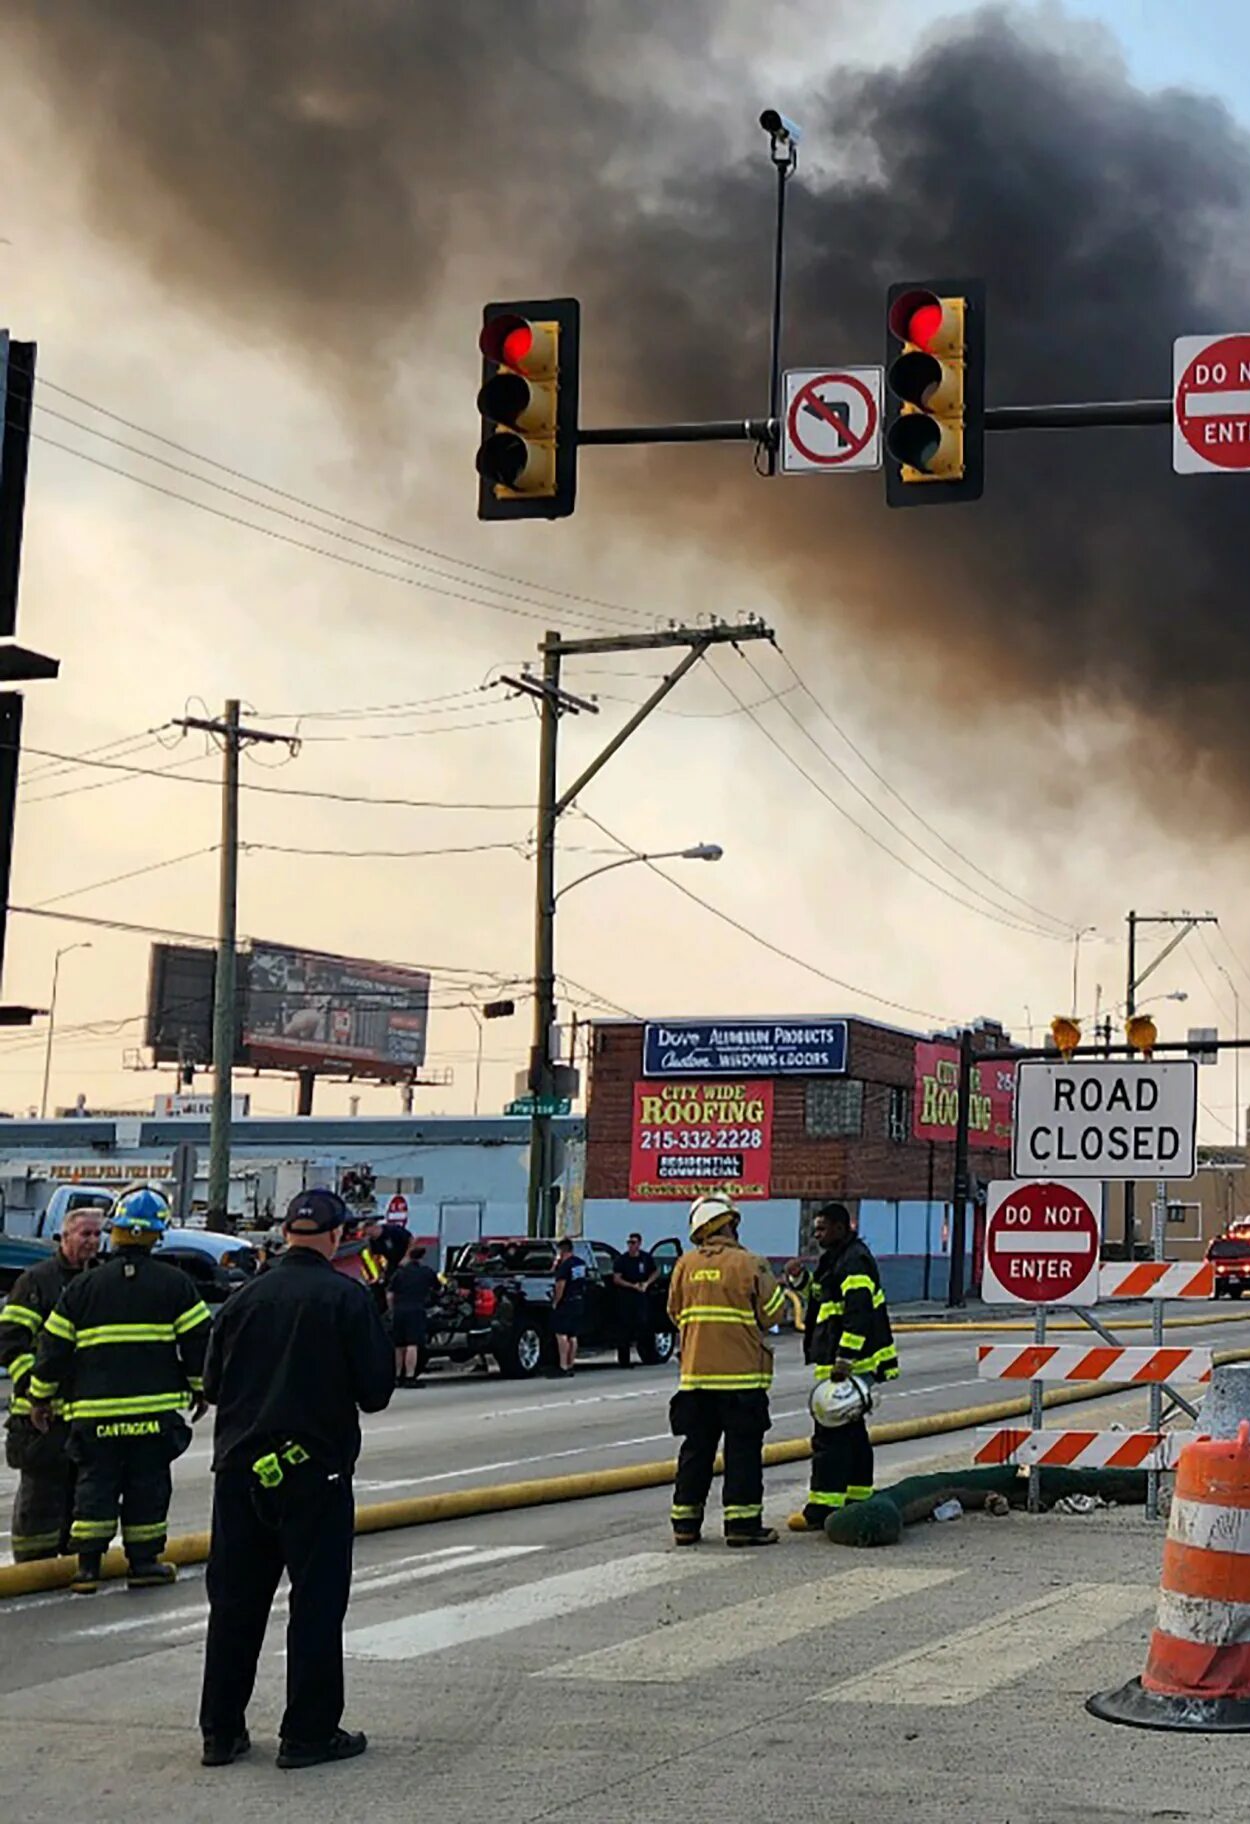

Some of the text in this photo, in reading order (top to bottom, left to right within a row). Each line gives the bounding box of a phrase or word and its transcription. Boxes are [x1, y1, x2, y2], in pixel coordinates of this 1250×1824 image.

[1195, 363, 1227, 385] DO
[774, 1027, 834, 1044] PRODUCTS
[718, 1053, 778, 1068] WINDOWS
[662, 1084, 746, 1100] CITY WIDE
[1054, 1078, 1158, 1112] ROAD
[640, 1096, 764, 1125] ROOFING
[920, 1075, 991, 1132] ROOING
[640, 1128, 762, 1149] 215-332-2228
[1030, 1126, 1180, 1161] CLOSED
[660, 1156, 740, 1166] RESIDENTIAL
[659, 1167, 740, 1177] COMMERCIAL
[1005, 1205, 1084, 1226] DO NOT
[1009, 1259, 1073, 1279] ENTER
